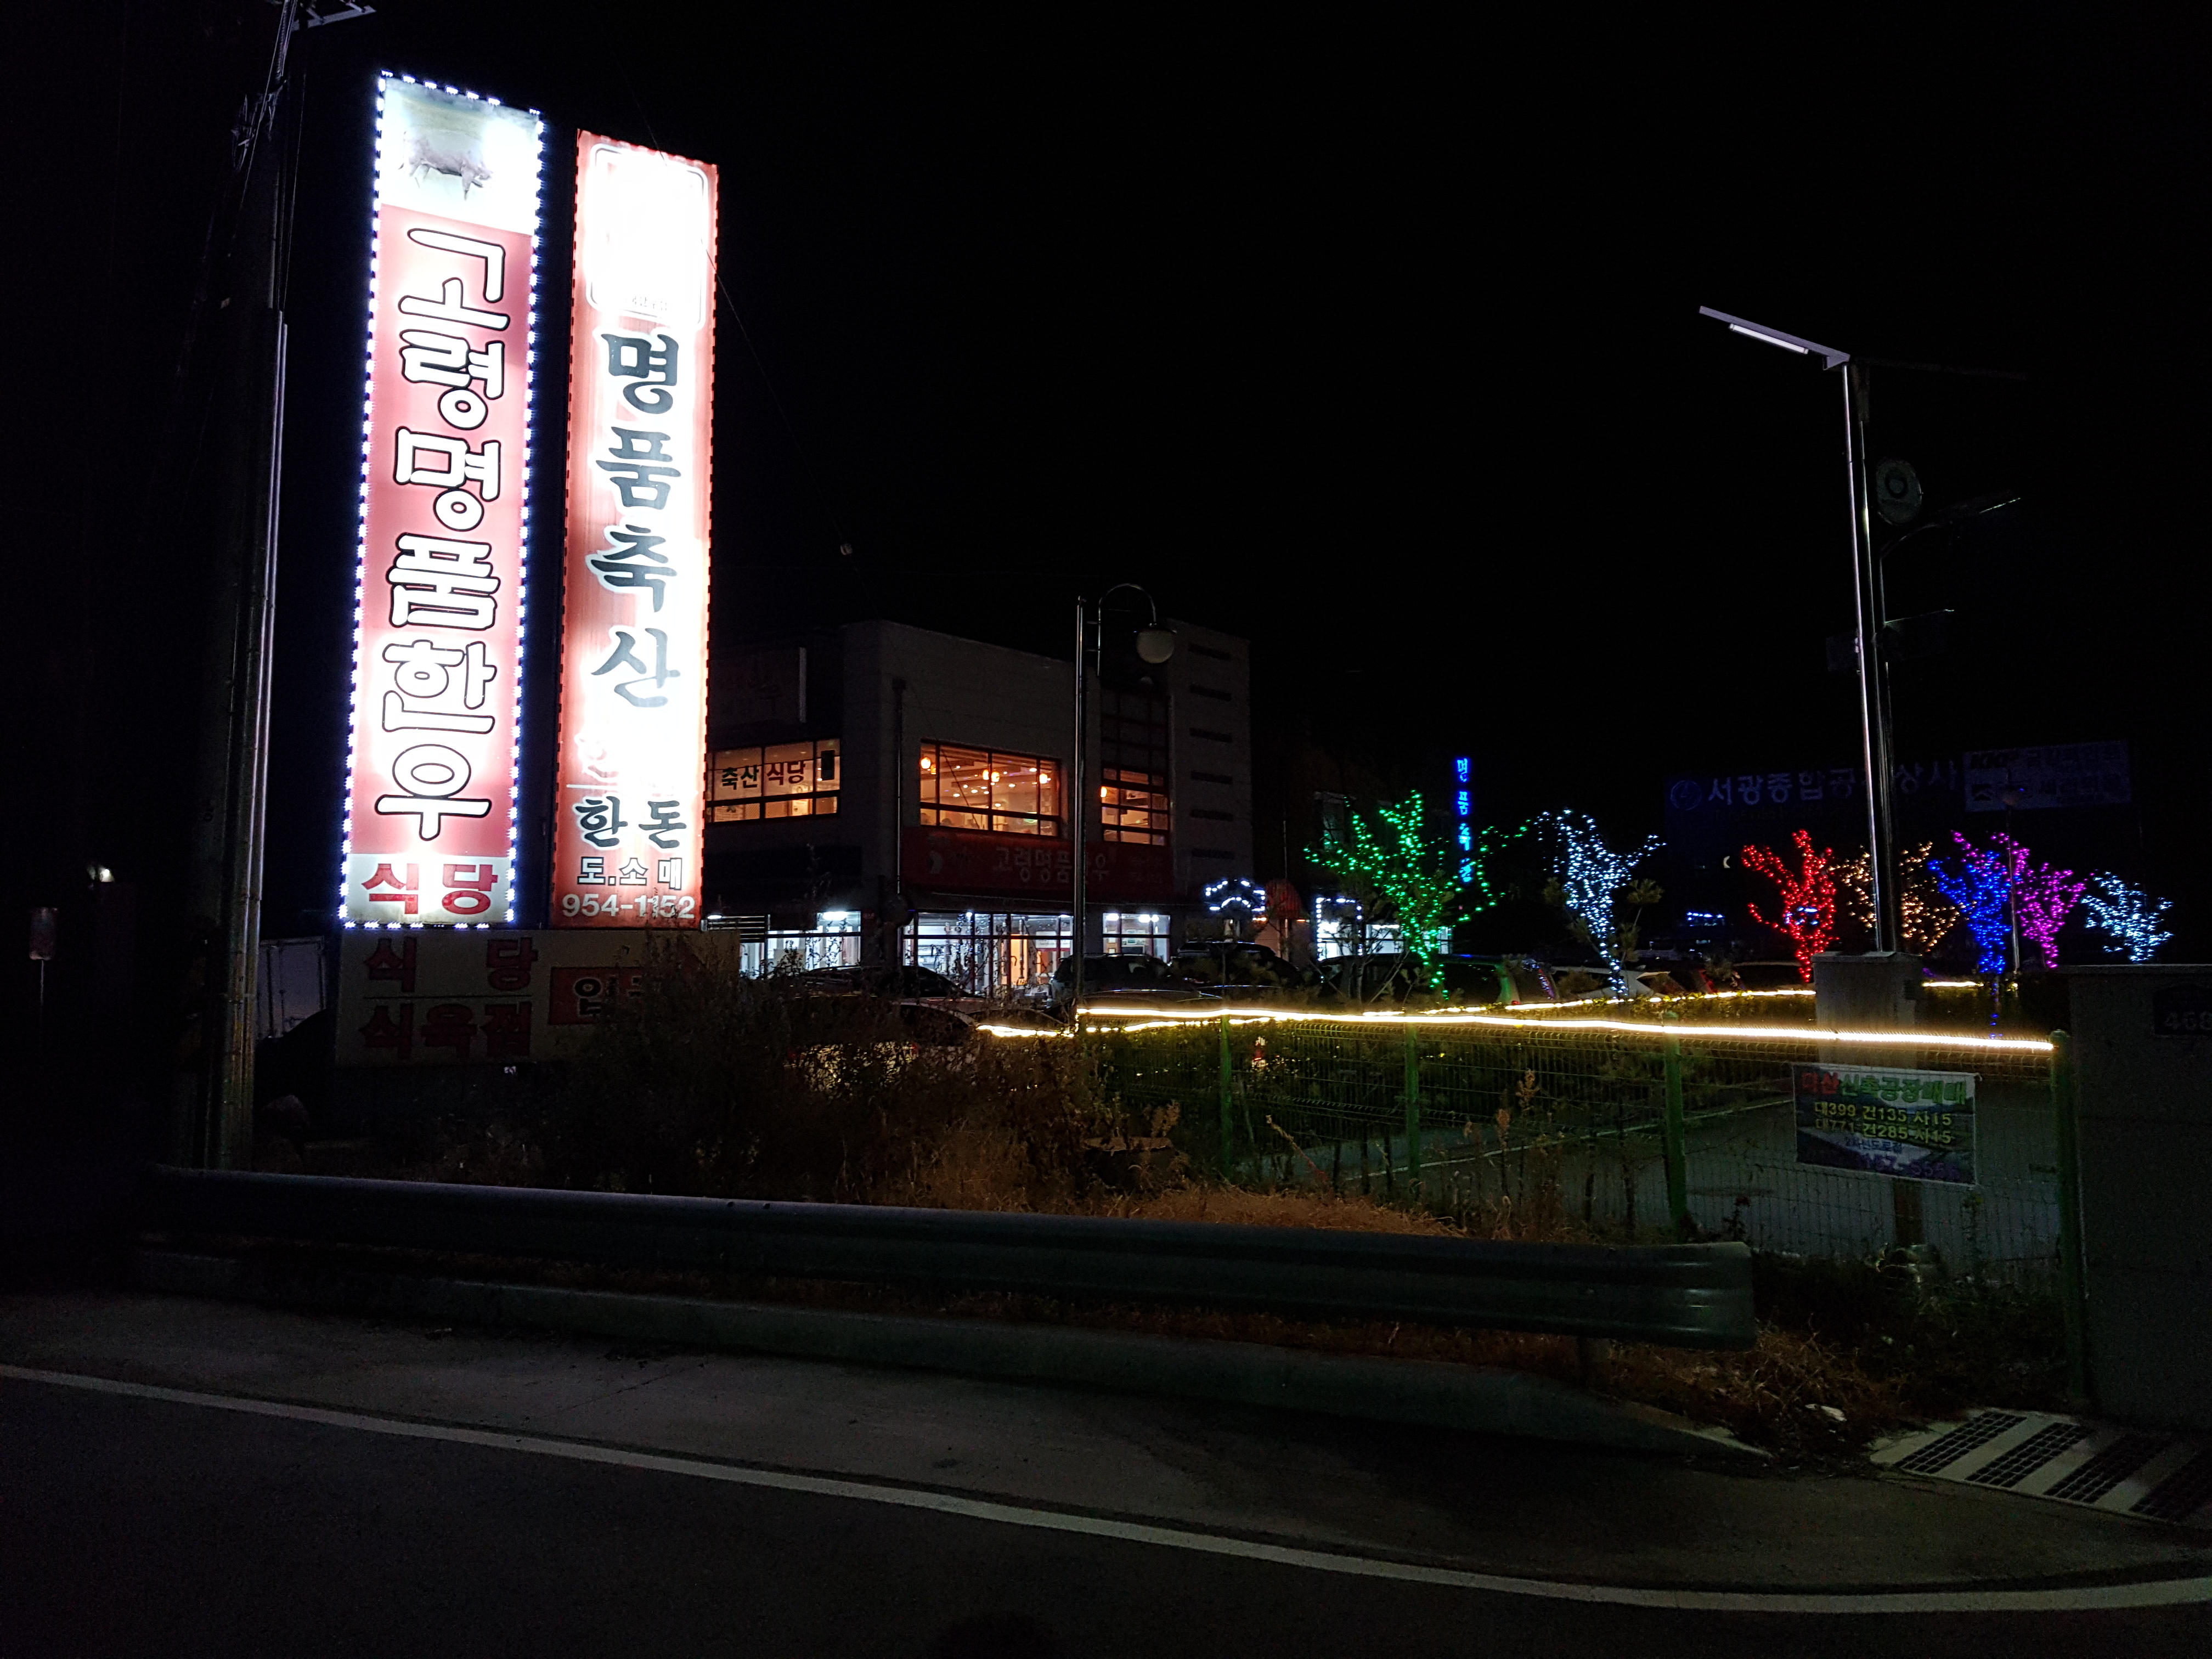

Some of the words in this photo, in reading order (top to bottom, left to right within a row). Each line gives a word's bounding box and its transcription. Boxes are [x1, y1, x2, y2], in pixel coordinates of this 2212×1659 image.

[374, 227, 510, 841] 고령명품한우
[590, 332, 682, 708] 명품축산
[721, 765, 760, 791] 축산
[767, 761, 806, 786] 식당
[1708, 760, 1957, 805] 서광종합공상사
[581, 795, 687, 849] 한돈
[362, 863, 499, 915] 식당
[992, 847, 1110, 884] 고령명품우
[562, 893, 695, 919] 954-1152
[359, 1001, 532, 1060] 식육점
[1862, 1105, 1908, 1122] 건135
